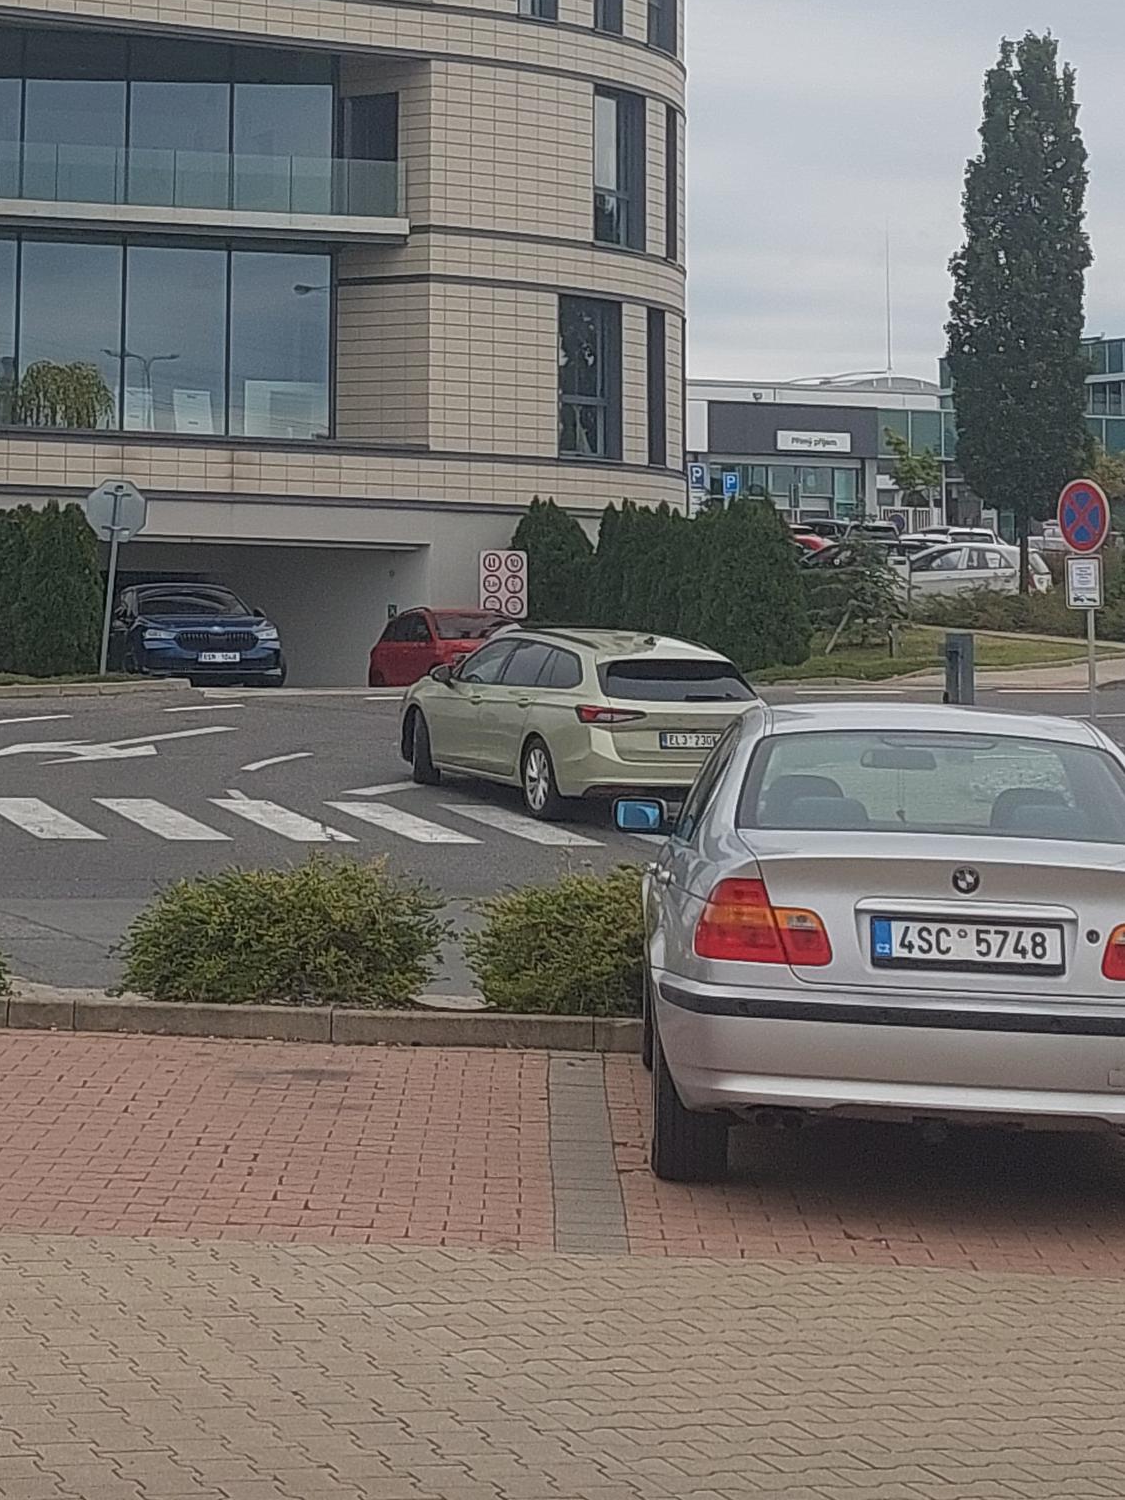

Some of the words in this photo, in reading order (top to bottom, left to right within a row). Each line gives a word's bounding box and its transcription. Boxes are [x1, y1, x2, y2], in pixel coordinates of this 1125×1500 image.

[692, 467, 703, 482] P
[726, 475, 736, 488] P
[898, 925, 952, 955] 4SC
[975, 928, 1048, 960] 5748
